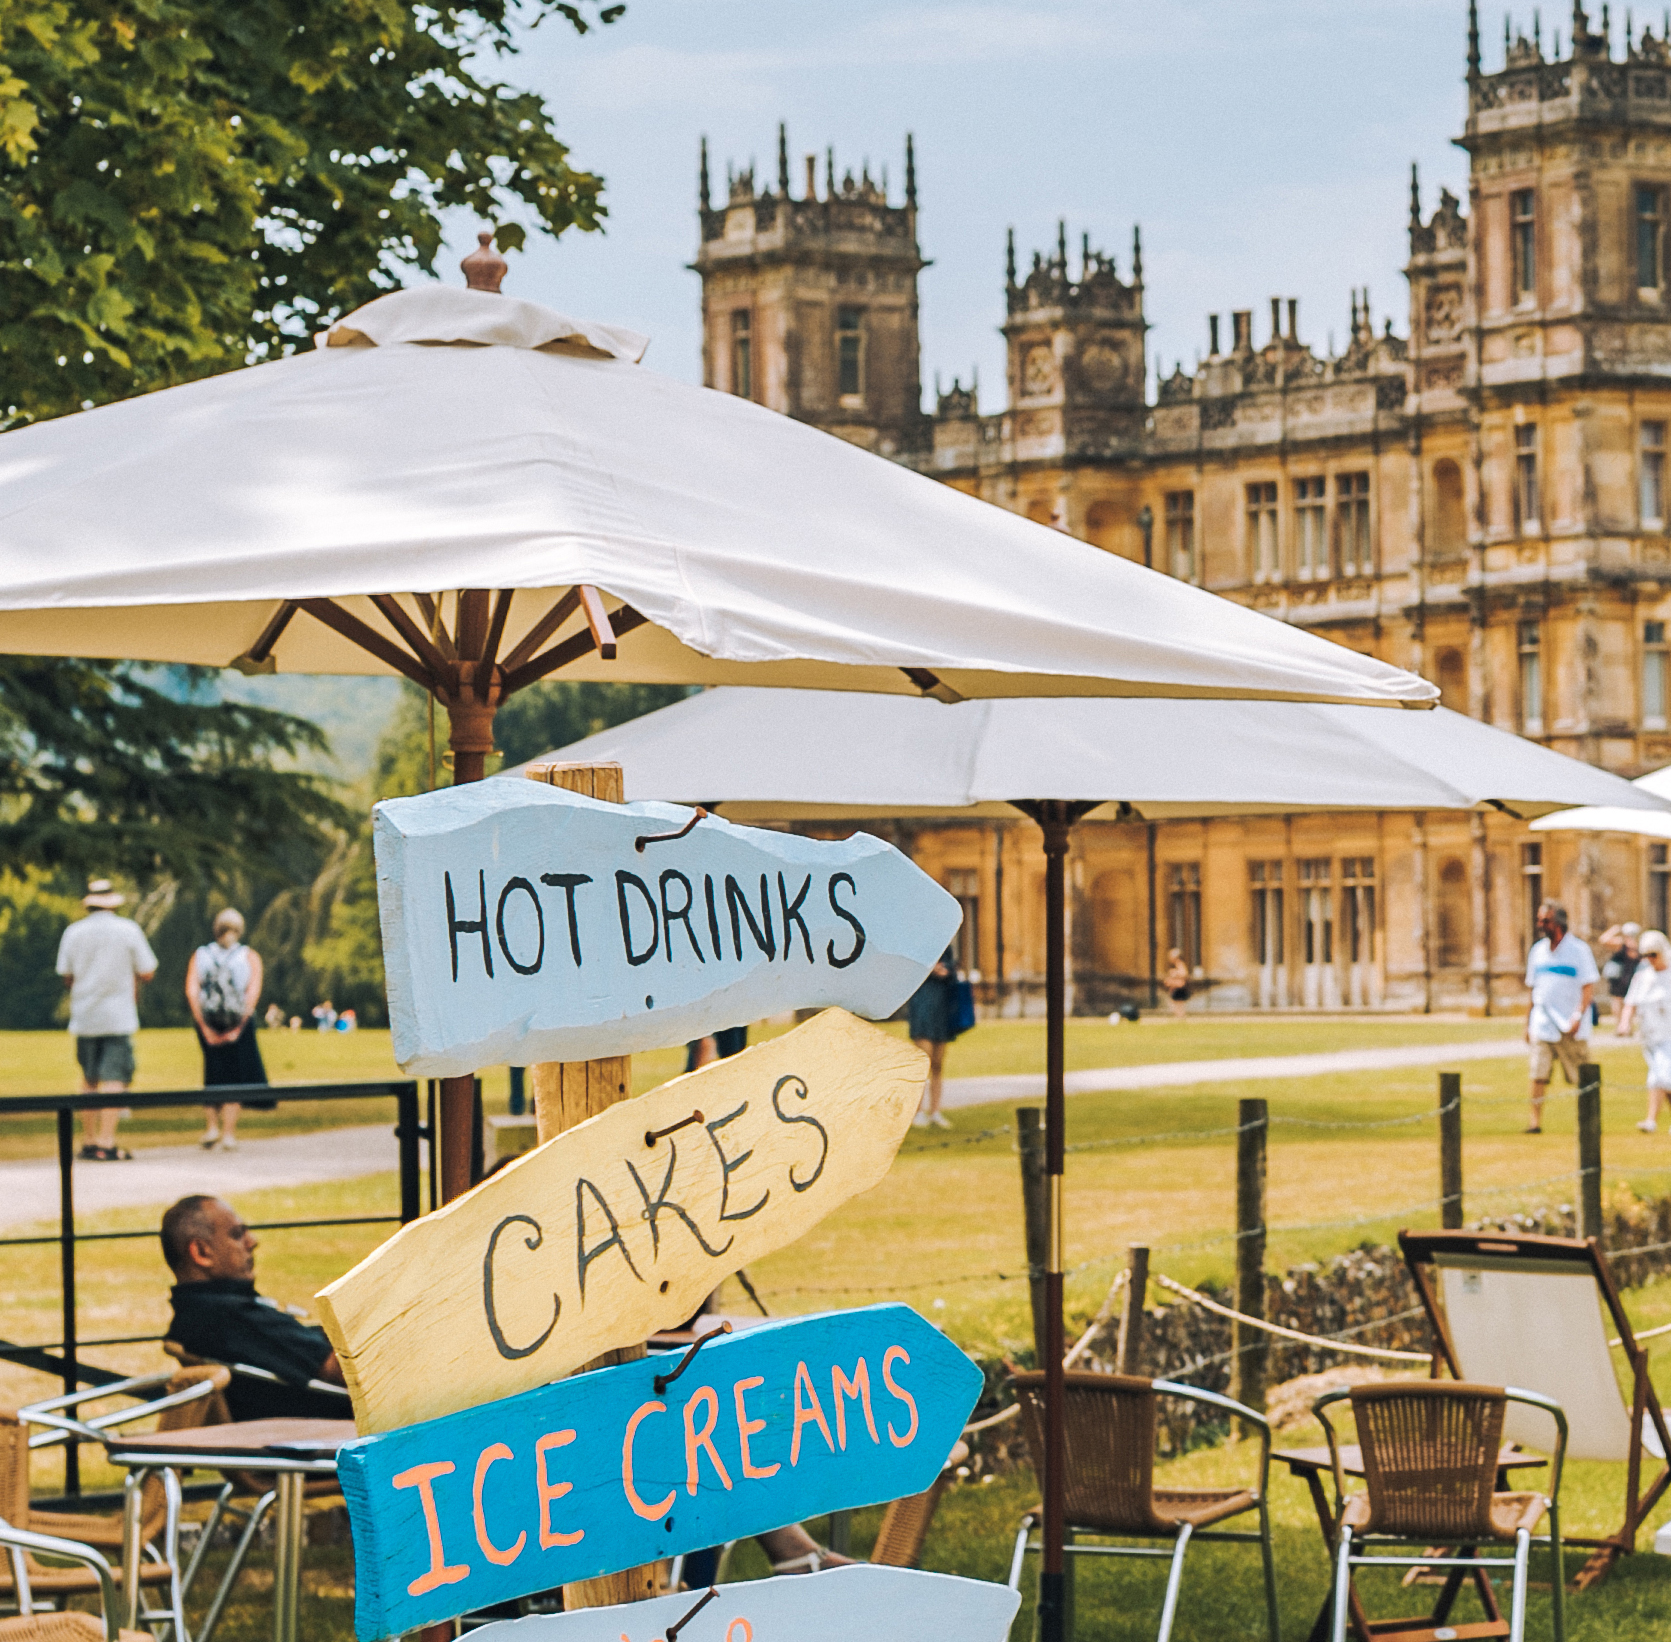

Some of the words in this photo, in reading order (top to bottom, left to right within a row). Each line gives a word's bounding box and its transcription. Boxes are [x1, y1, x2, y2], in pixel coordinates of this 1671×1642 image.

[444, 868, 593, 982] HOT
[616, 868, 867, 970] DRINKS
[482, 1074, 829, 1359] CAKES
[391, 1427, 587, 1598] ICE
[621, 1344, 920, 1522] CREAMS
